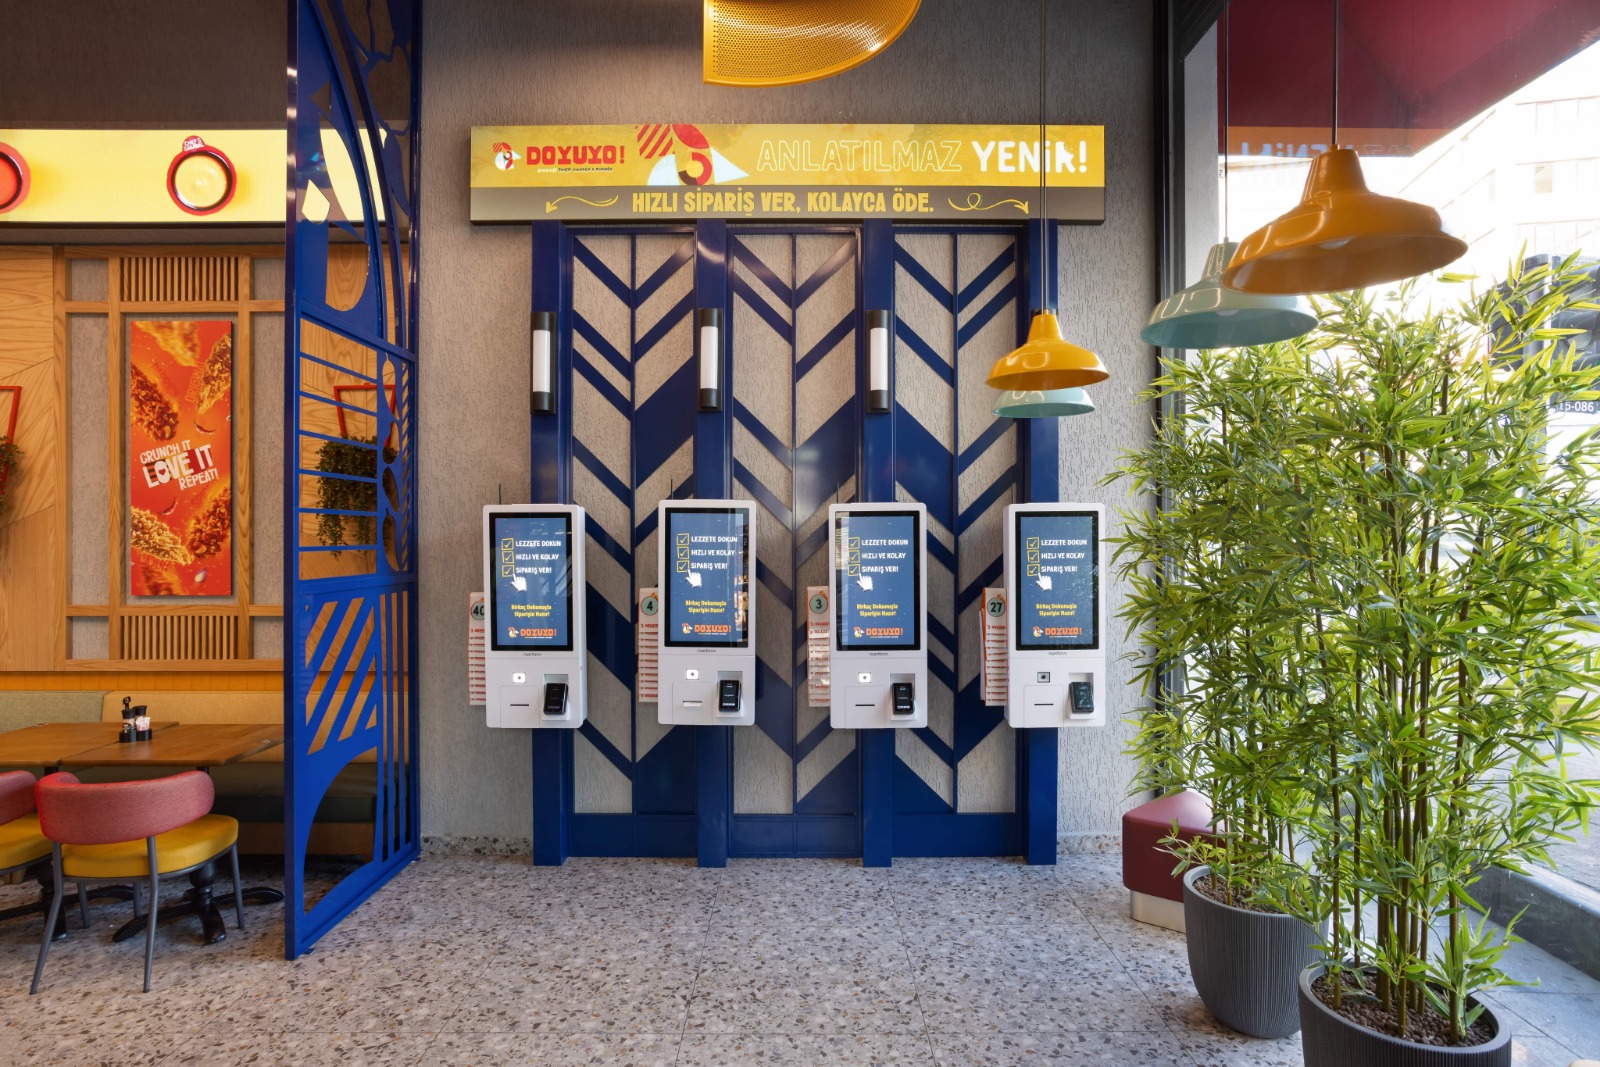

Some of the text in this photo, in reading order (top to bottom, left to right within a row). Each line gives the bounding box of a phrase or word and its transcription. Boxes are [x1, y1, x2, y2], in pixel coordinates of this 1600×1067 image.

[527, 145, 625, 165] DOYUYO!
[756, 140, 962, 172] ANLATILMAZ
[632, 187, 934, 216] HIZLI SİPARİŞ VER, KOLAYCA ÖDE.
[140, 439, 191, 464] CRUNCH IT
[142, 443, 214, 489] LOVE IT
[178, 468, 219, 491] REPEAT!
[646, 600, 654, 611] 4
[815, 599, 823, 610] 3
[990, 602, 1003, 613] 27
